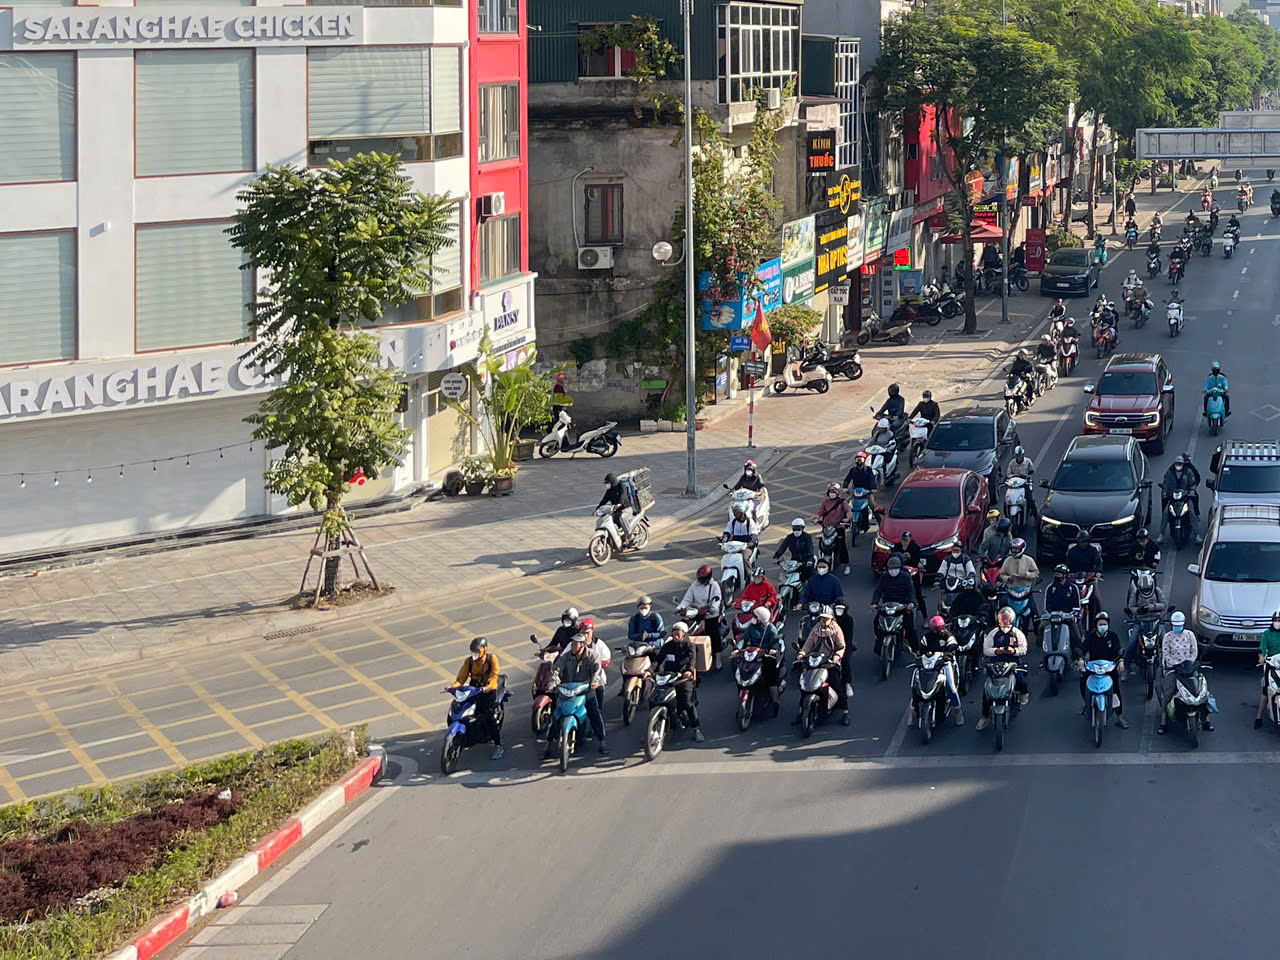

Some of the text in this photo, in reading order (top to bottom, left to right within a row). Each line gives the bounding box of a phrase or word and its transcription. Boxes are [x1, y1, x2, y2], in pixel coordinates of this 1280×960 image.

[23, 14, 354, 41] SARANGHAE CHICKEN
[812, 136, 831, 150] KÍNH
[809, 152, 834, 168] THUỐC
[0, 358, 225, 416] RANGHAE
